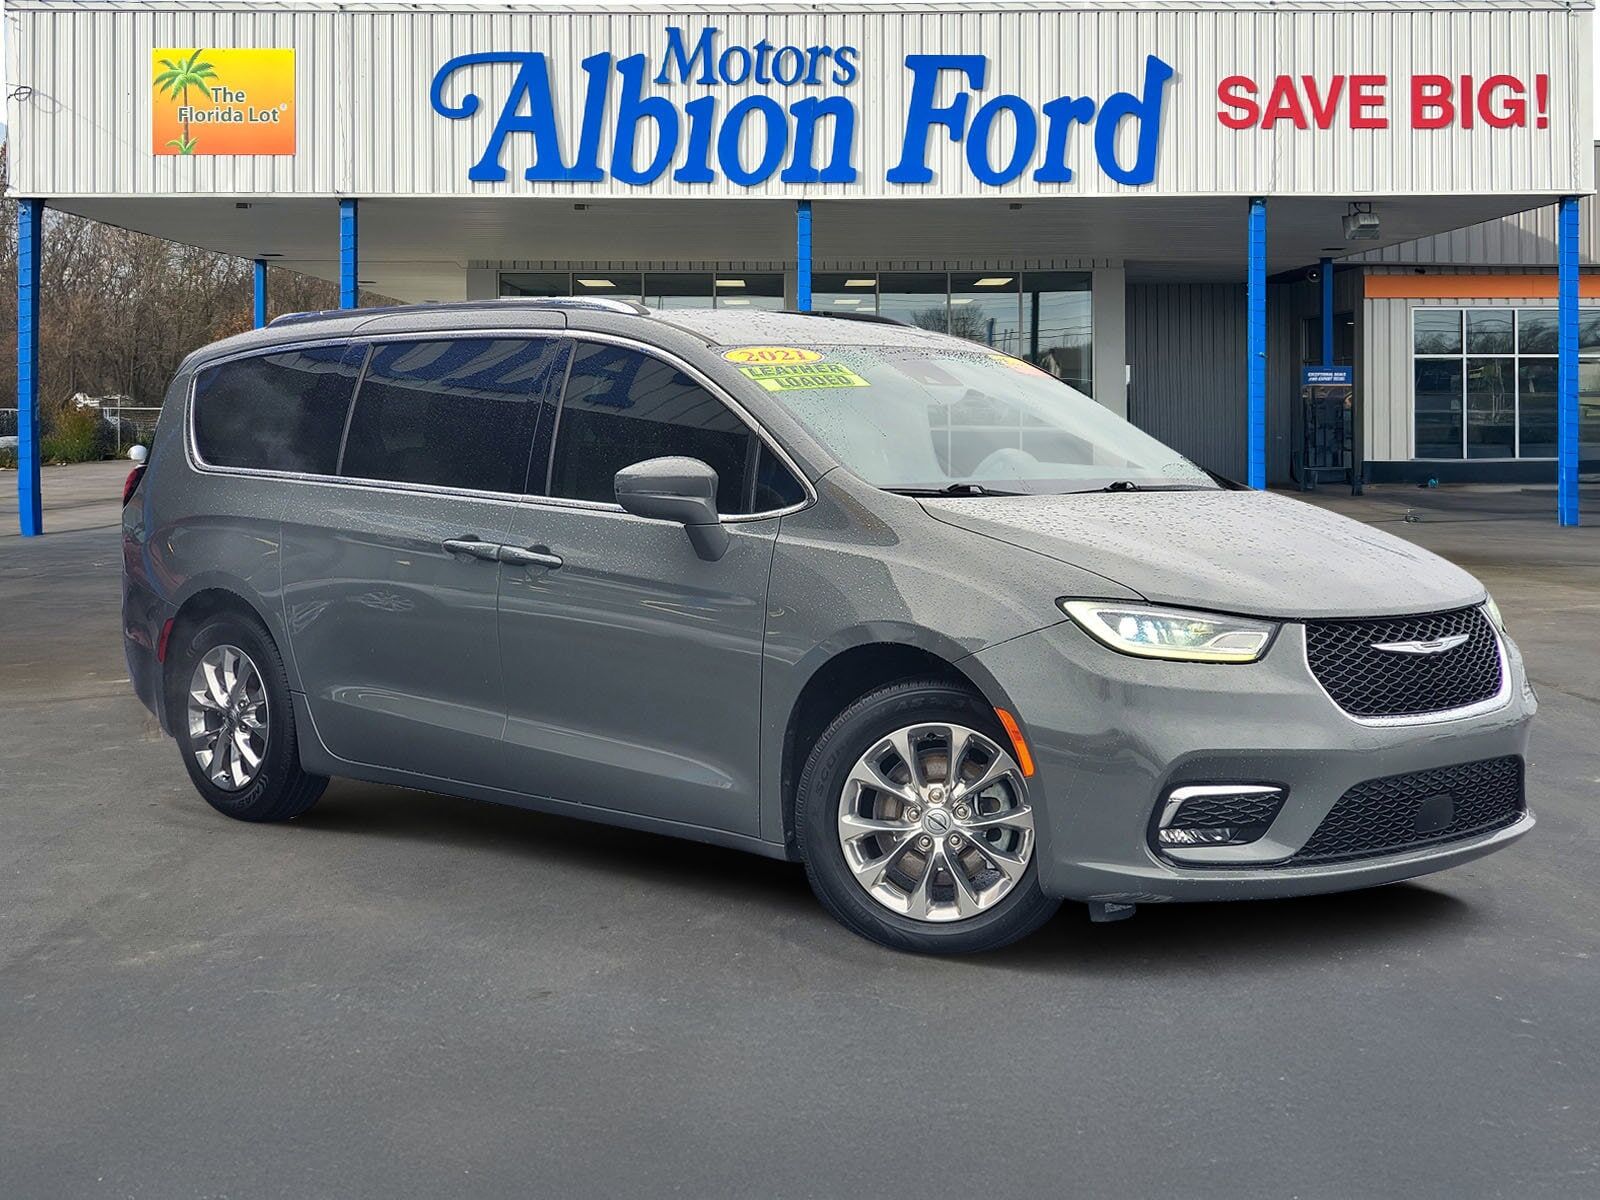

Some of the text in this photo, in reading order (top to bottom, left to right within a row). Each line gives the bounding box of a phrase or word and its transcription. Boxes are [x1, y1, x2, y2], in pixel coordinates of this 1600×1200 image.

[653, 27, 860, 86] Motors
[211, 86, 246, 103] The
[1217, 73, 1548, 129] SAVE BIG!
[178, 107, 279, 122] Florida Lot
[430, 51, 1174, 186] Albion Ford
[739, 350, 807, 362] 2021
[747, 363, 846, 377] LEATHER
[775, 375, 853, 388] LOADED
